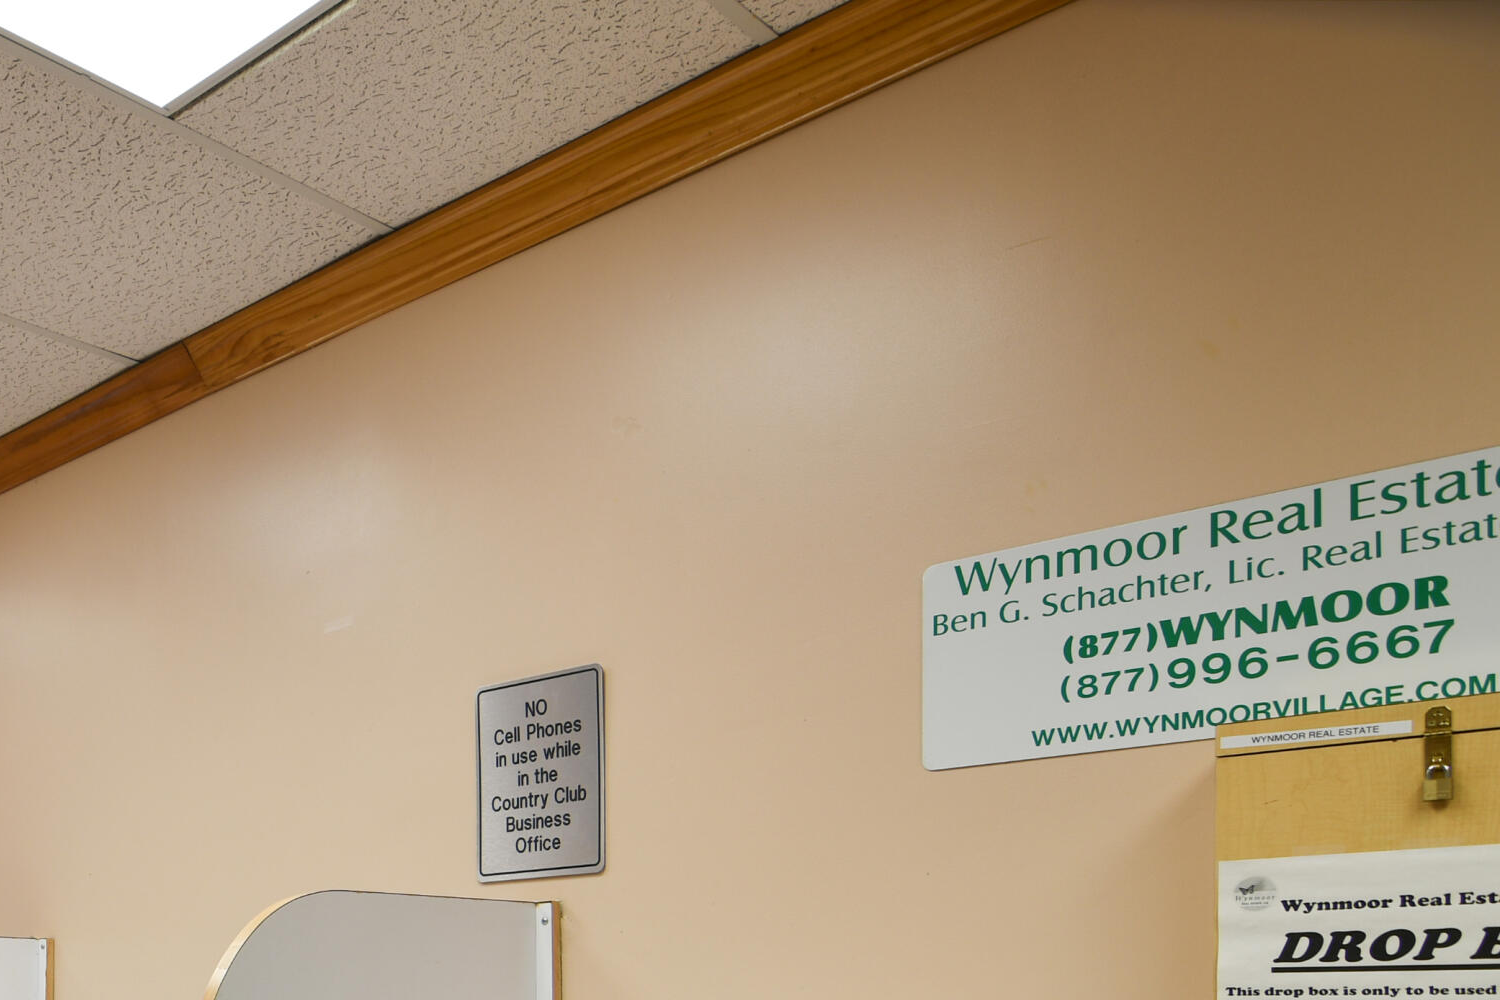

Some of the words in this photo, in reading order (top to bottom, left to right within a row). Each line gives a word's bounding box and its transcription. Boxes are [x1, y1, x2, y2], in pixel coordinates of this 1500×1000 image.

[954, 524, 1188, 598] Wynmoor
[1209, 488, 1322, 548] Real
[1349, 459, 1500, 522] Estat
[932, 610, 987, 636] Ben
[999, 601, 1030, 624] G.
[1041, 570, 1212, 617] Schachter,
[1228, 557, 1285, 585] Lic.
[1301, 533, 1382, 572] Real
[1400, 513, 1500, 554] Estat
[525, 699, 547, 717] NO
[1031, 673, 1496, 748] WWW.WYNMOORVILLAGE.COM
[494, 726, 520, 745] Cell
[527, 719, 582, 741] Phones
[1251, 731, 1306, 744] WYNMOOR
[1308, 728, 1335, 739] REAL
[1338, 725, 1380, 737] ESTATE
[495, 752, 506, 767] in
[512, 750, 538, 765] use
[543, 740, 581, 760] while
[517, 771, 529, 787] in
[534, 767, 558, 784] the
[491, 793, 548, 812] Country
[554, 785, 587, 804] Club
[506, 813, 571, 832] Business
[515, 837, 561, 853] Office
[1281, 896, 1393, 914] Wynmoor
[1399, 892, 1452, 907] Real
[1458, 891, 1500, 905] Est
[1272, 928, 1463, 963] DROP
[1225, 986, 1260, 997] This
[1264, 986, 1304, 998] drop
[1308, 986, 1339, 997] box
[1343, 985, 1358, 996] is
[1361, 985, 1400, 997] only
[1405, 986, 1424, 995] to
[1429, 985, 1450, 995] be
[1454, 985, 1497, 995] used
